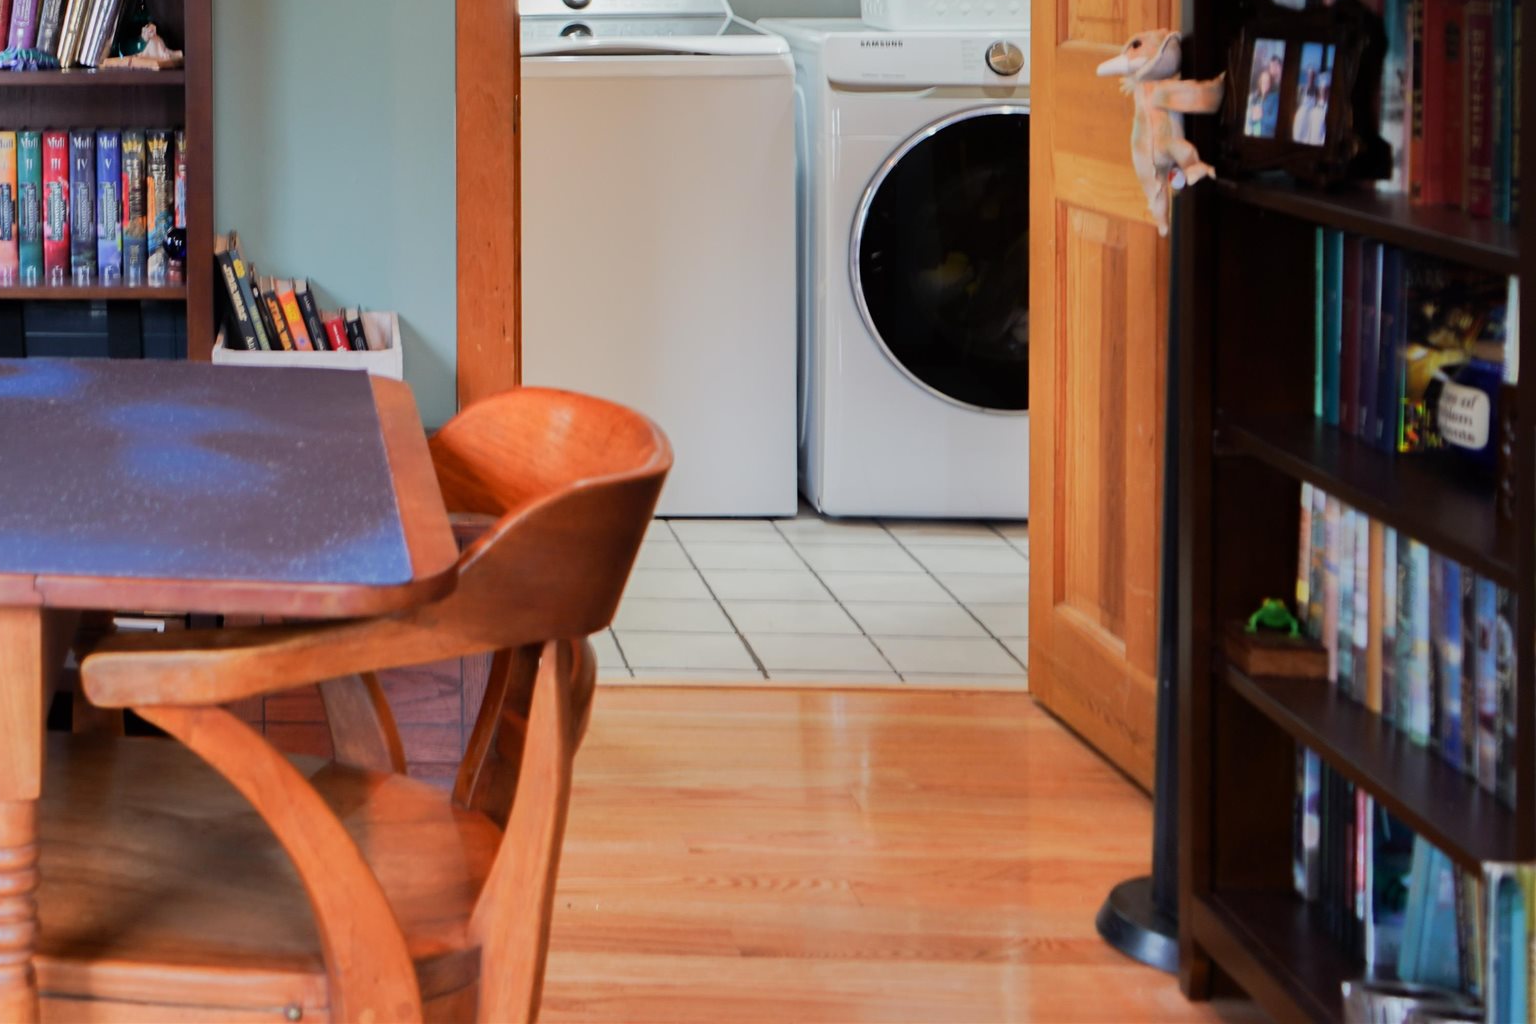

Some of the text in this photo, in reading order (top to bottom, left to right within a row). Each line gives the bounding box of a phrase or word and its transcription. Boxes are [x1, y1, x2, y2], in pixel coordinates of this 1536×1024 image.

[860, 40, 904, 49] SAMSUNG
[99, 136, 118, 149] Mull
[51, 158, 62, 169] III
[77, 158, 89, 171] IV
[105, 158, 113, 169] V
[222, 263, 249, 322] STAR WARS
